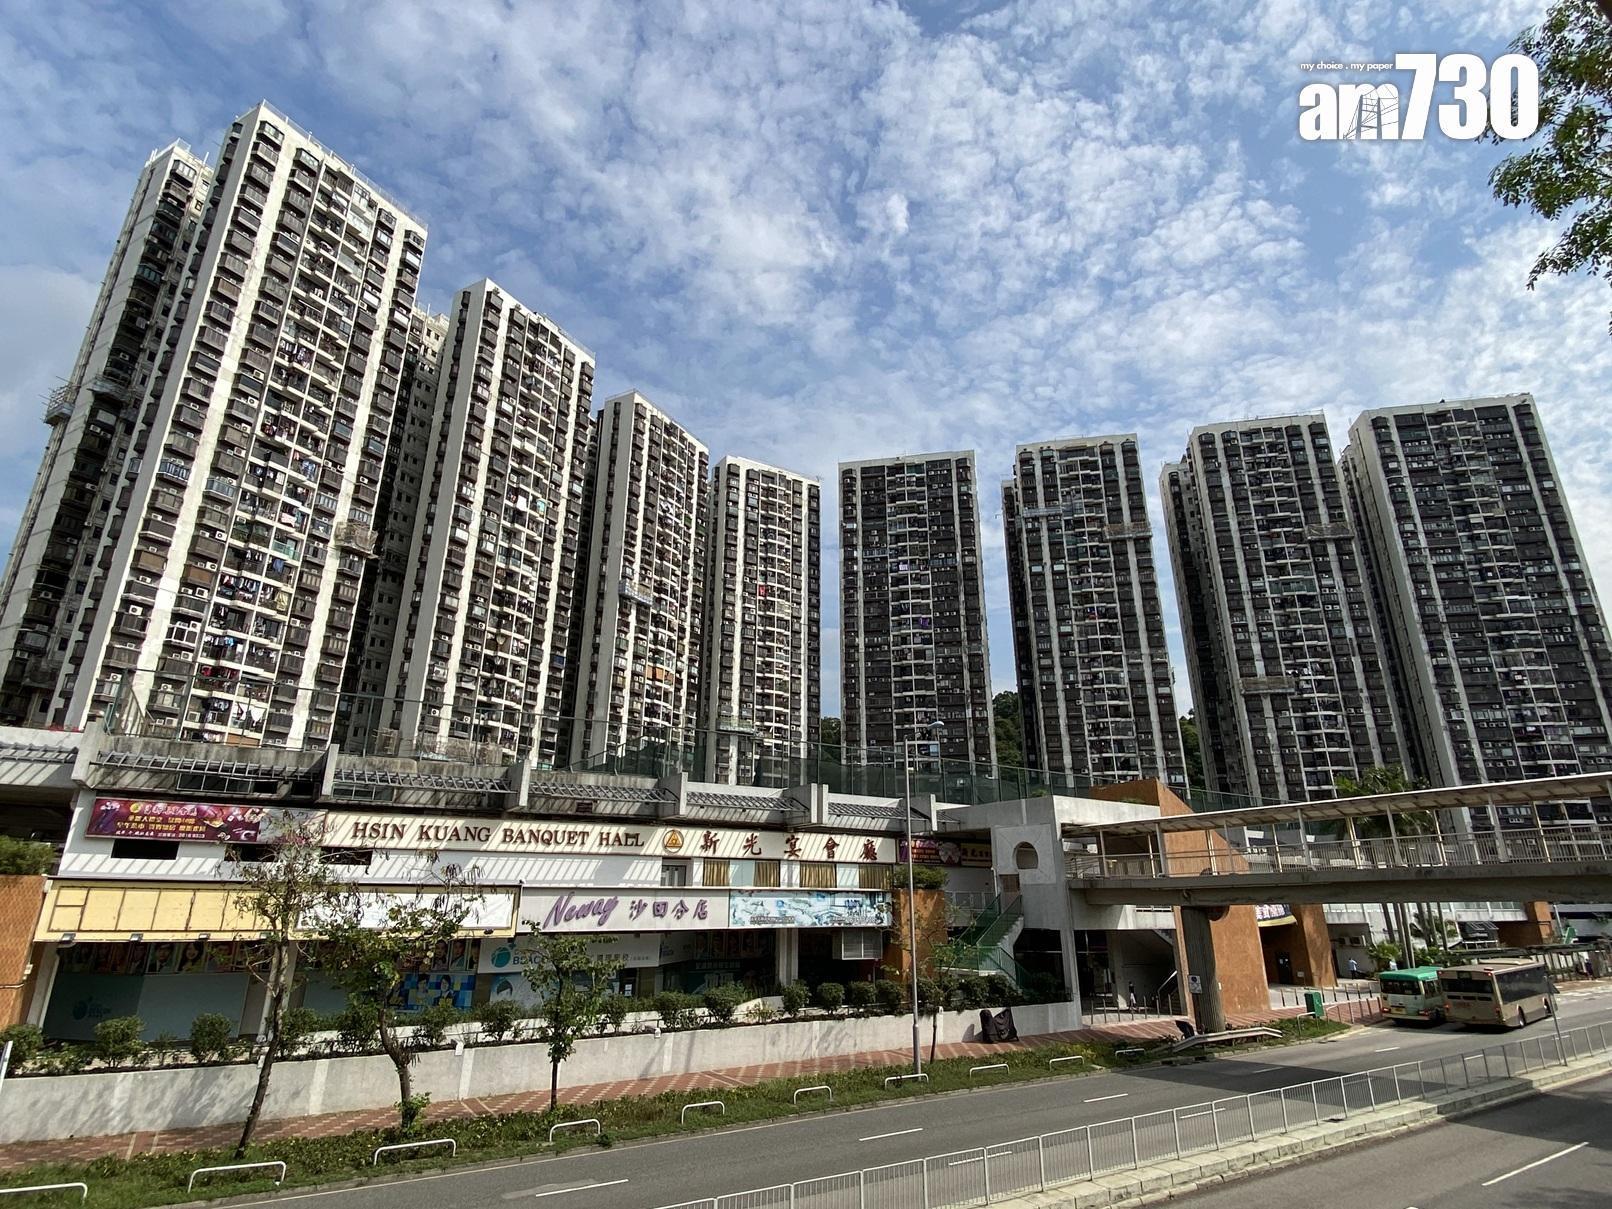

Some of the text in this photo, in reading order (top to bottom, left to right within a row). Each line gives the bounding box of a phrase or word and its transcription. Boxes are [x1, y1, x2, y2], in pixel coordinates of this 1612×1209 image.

[352, 822, 645, 847] HSIN KUANG BANQUET HALL
[700, 831, 880, 861] 新光宴會廳
[542, 891, 620, 930] Neway
[629, 899, 708, 921] 沙田分店
